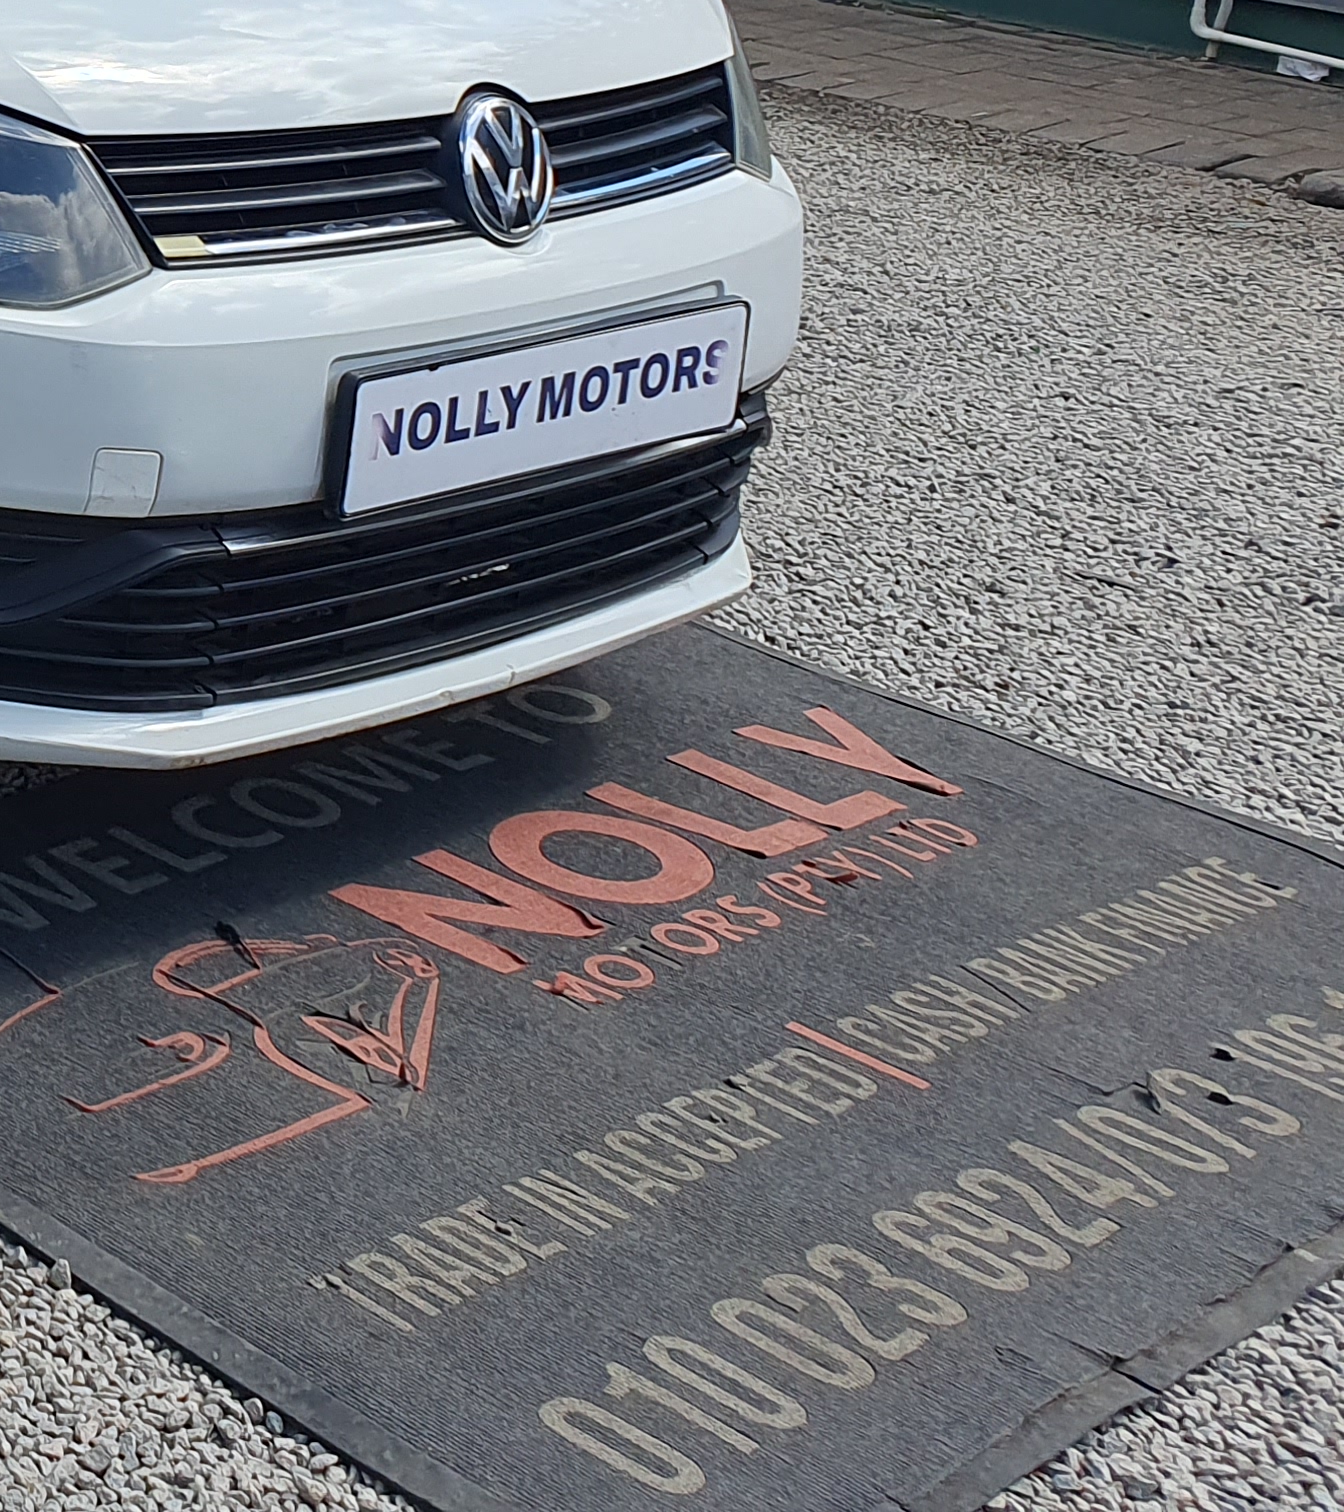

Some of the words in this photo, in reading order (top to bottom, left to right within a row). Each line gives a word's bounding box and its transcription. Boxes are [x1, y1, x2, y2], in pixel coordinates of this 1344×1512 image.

[368, 380, 531, 462] NOLLY
[536, 339, 730, 424] MOTORS
[447, 685, 611, 745] TO
[328, 704, 964, 975] NOLLY
[532, 893, 782, 1008] MOTORS
[869, 816, 979, 863] LTD
[307, 1196, 570, 1334] TRADE
[502, 1167, 632, 1238] IN
[573, 1045, 879, 1207] ACCEPTED
[1076, 855, 1300, 956] FINANCE
[537, 1334, 809, 1495] 010
[710, 1241, 970, 1392] 023
